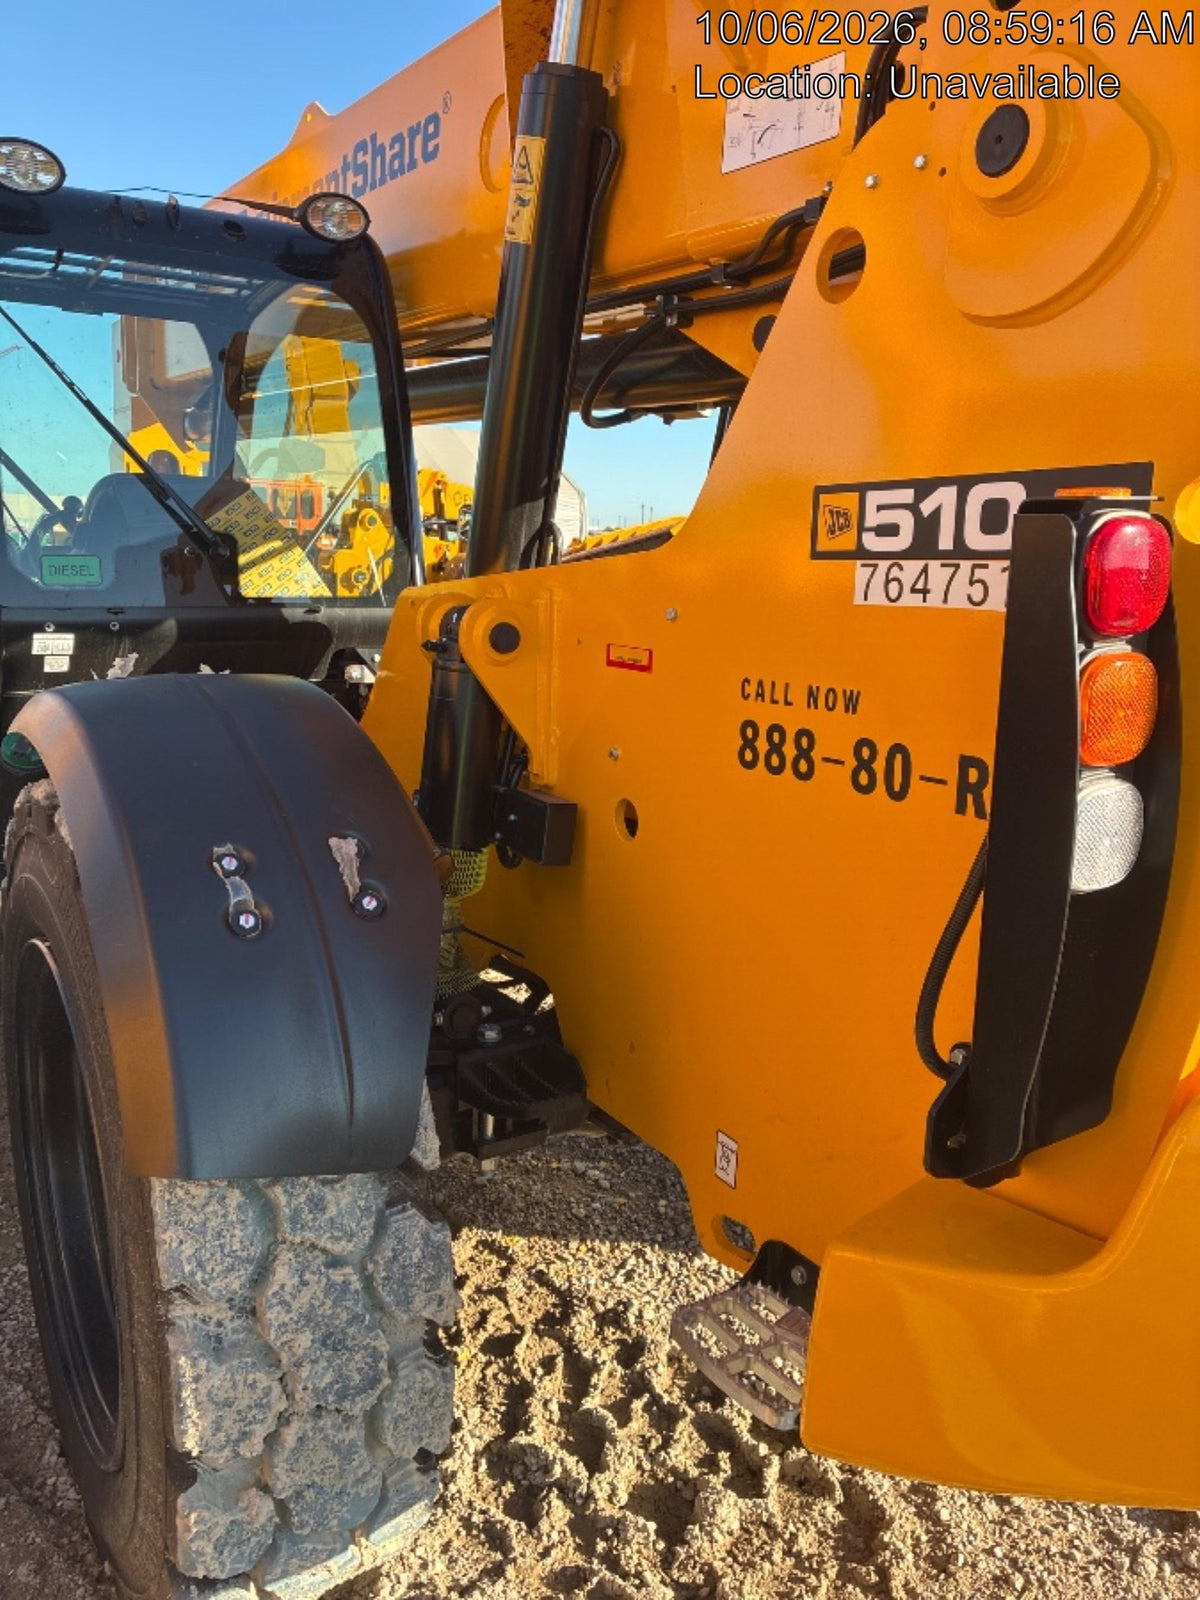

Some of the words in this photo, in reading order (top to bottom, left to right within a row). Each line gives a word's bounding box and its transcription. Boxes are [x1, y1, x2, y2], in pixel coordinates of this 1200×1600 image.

[827, 507, 851, 536] JCB
[861, 481, 1027, 552] 510
[47, 564, 96, 577] DIESEL
[859, 562, 1010, 608] 76475
[740, 677, 794, 706] CALL
[806, 684, 861, 715] NOW
